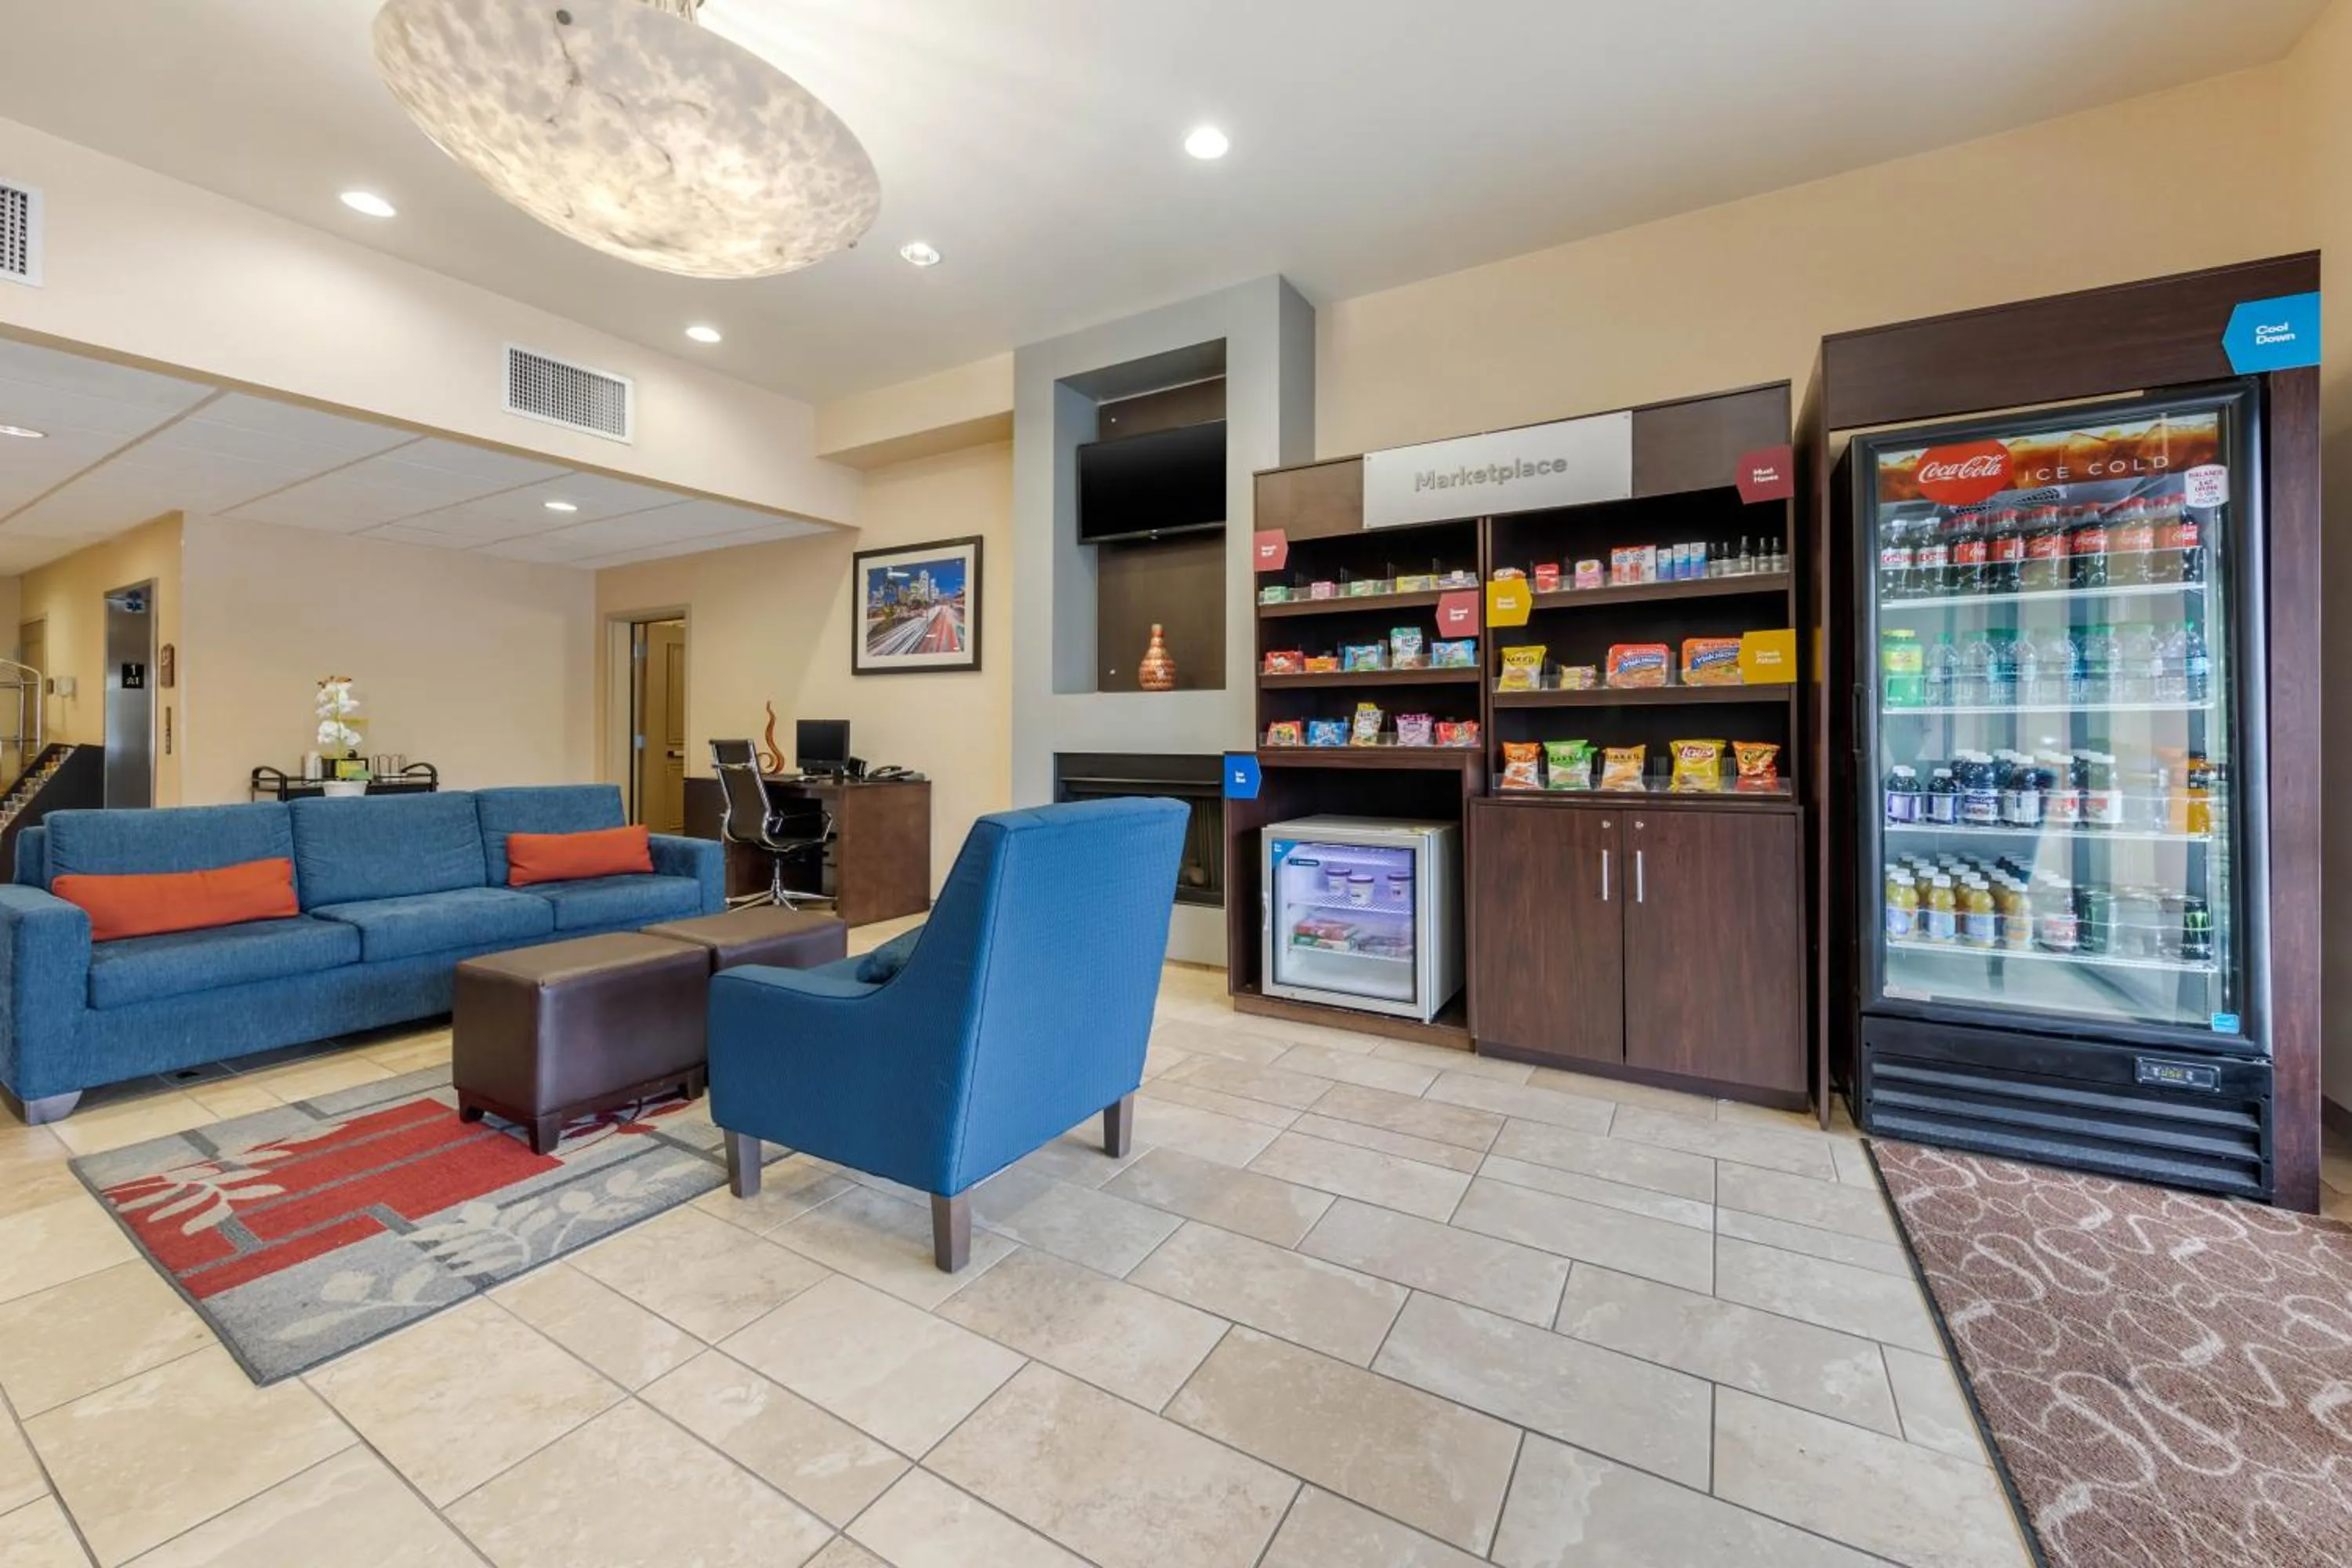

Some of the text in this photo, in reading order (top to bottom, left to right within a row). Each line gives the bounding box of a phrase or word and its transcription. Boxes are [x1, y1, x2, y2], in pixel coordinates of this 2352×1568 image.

[2256, 321, 2288, 335] Cool
[2256, 333, 2296, 346] Down
[1414, 457, 1568, 493] Marketplace
[1918, 454, 2006, 484] Coca-Cola
[2025, 456, 2169, 481] ICE COLD
